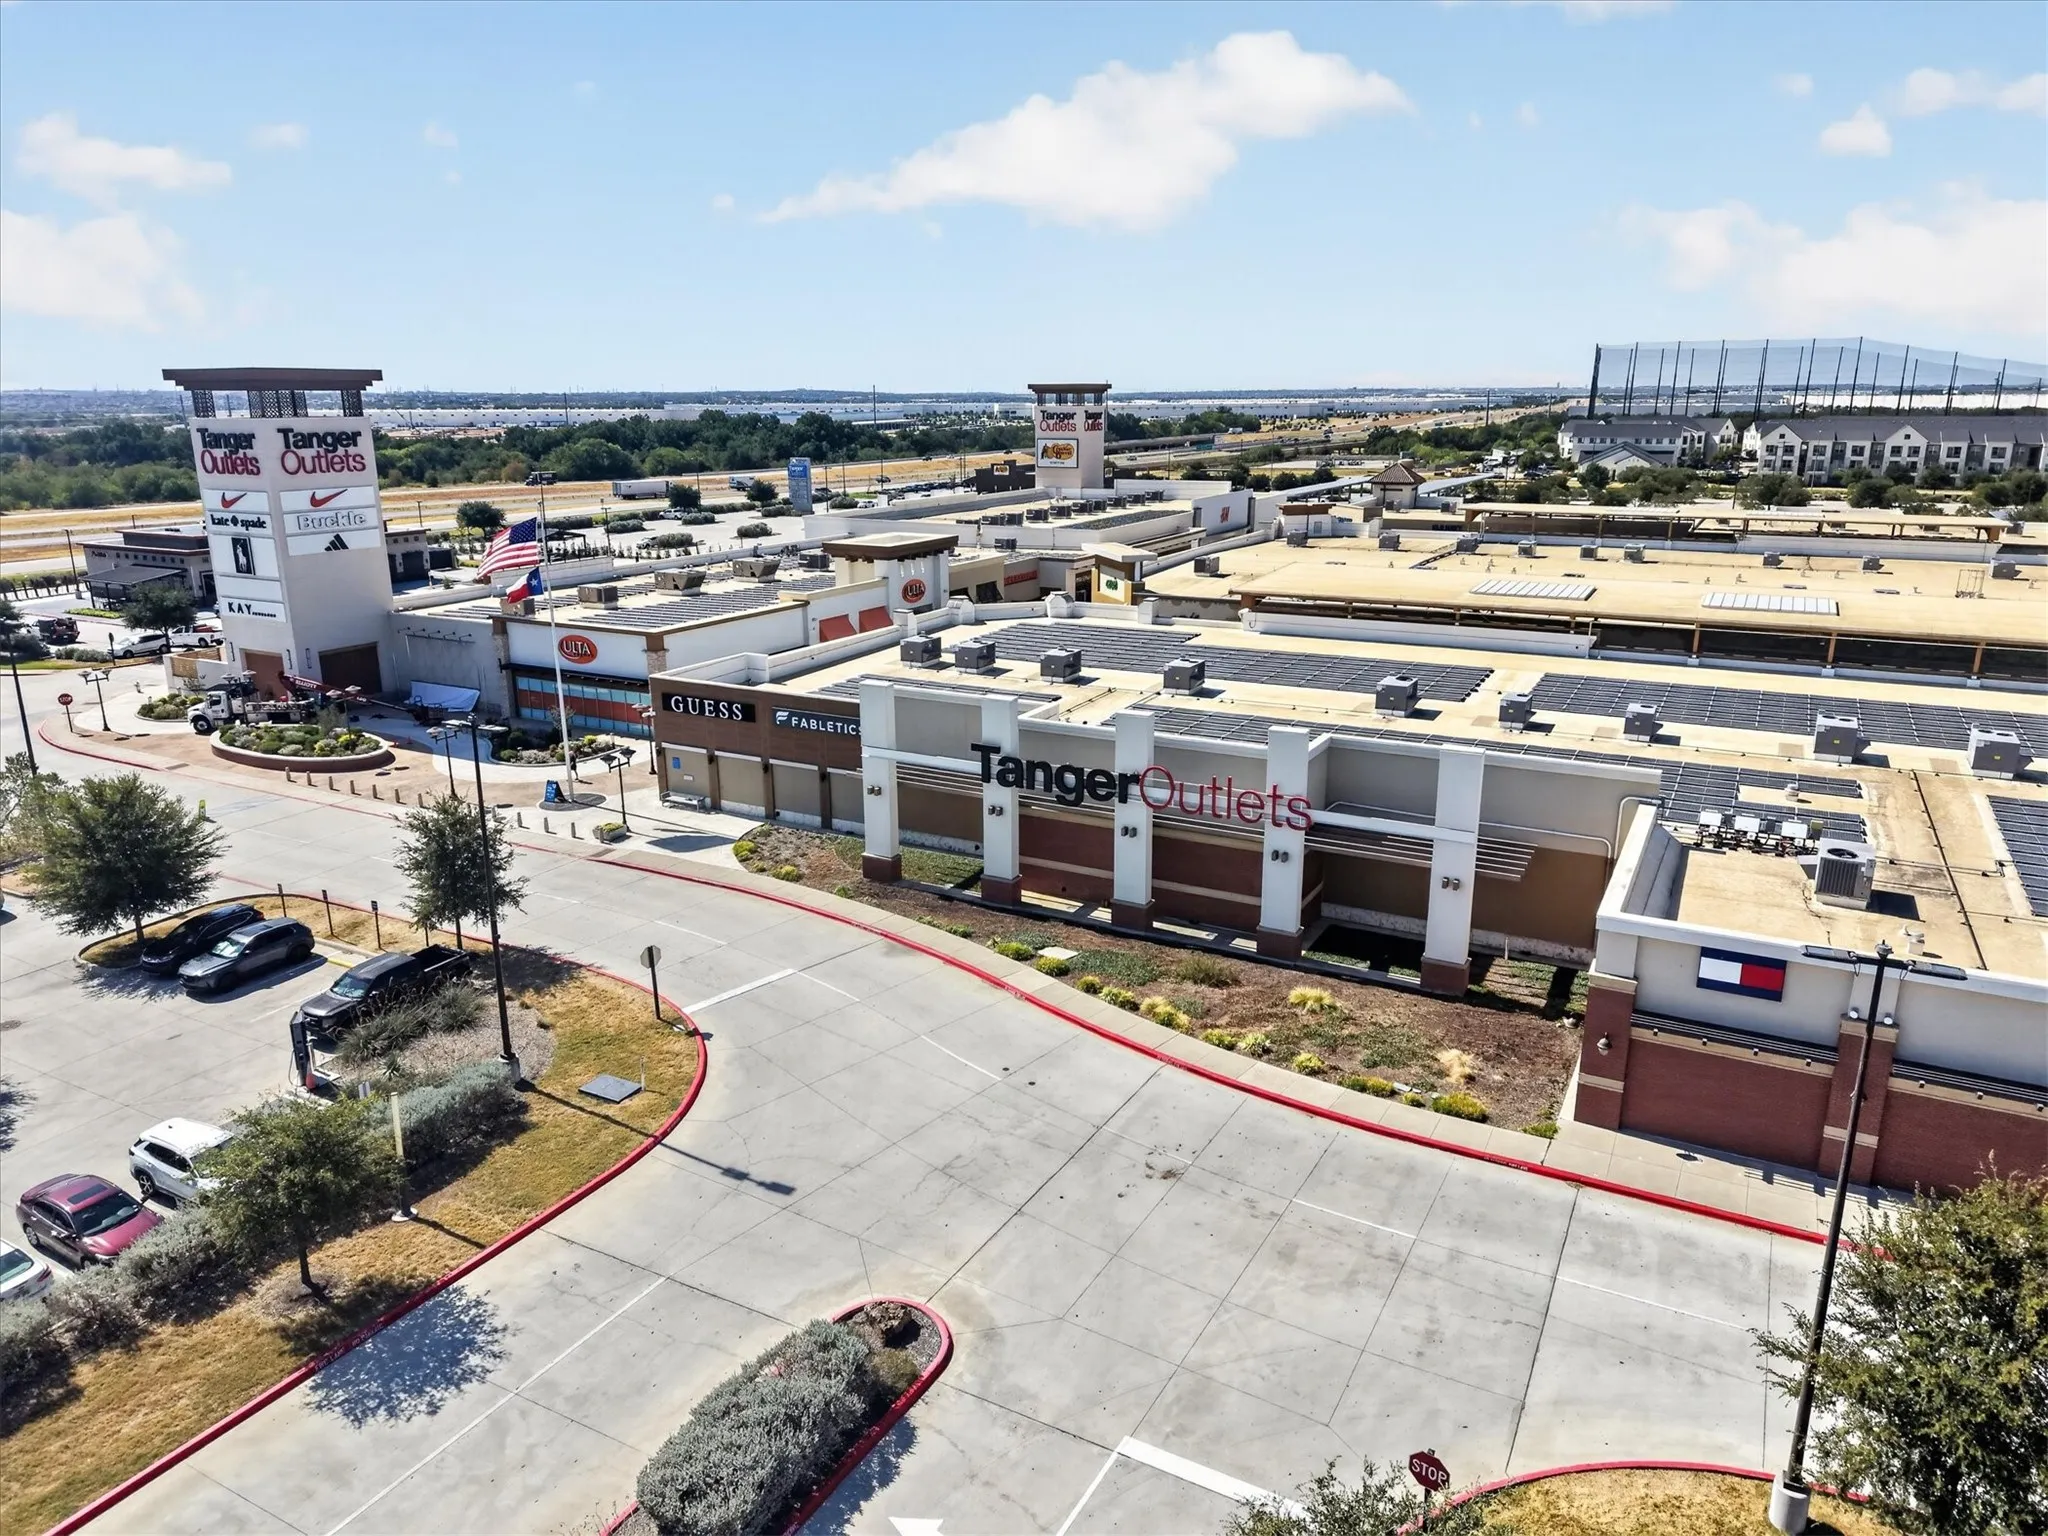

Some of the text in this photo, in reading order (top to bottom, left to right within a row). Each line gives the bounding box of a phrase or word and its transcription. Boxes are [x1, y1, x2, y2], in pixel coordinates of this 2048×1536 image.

[1040, 410, 1076, 422] Tanger
[1040, 420, 1077, 432] Outlets
[196, 428, 256, 455] Tanger
[277, 428, 362, 454] Tanger
[201, 449, 261, 476] Outlets
[281, 449, 366, 475] Outlets
[210, 514, 267, 531] kate spade
[297, 511, 367, 531] Buckle
[228, 602, 251, 615] KAY
[563, 640, 591, 655] ULTA
[670, 695, 743, 721] GUESS
[791, 716, 862, 736] FABLETIC
[1411, 1459, 1447, 1483] STOP
